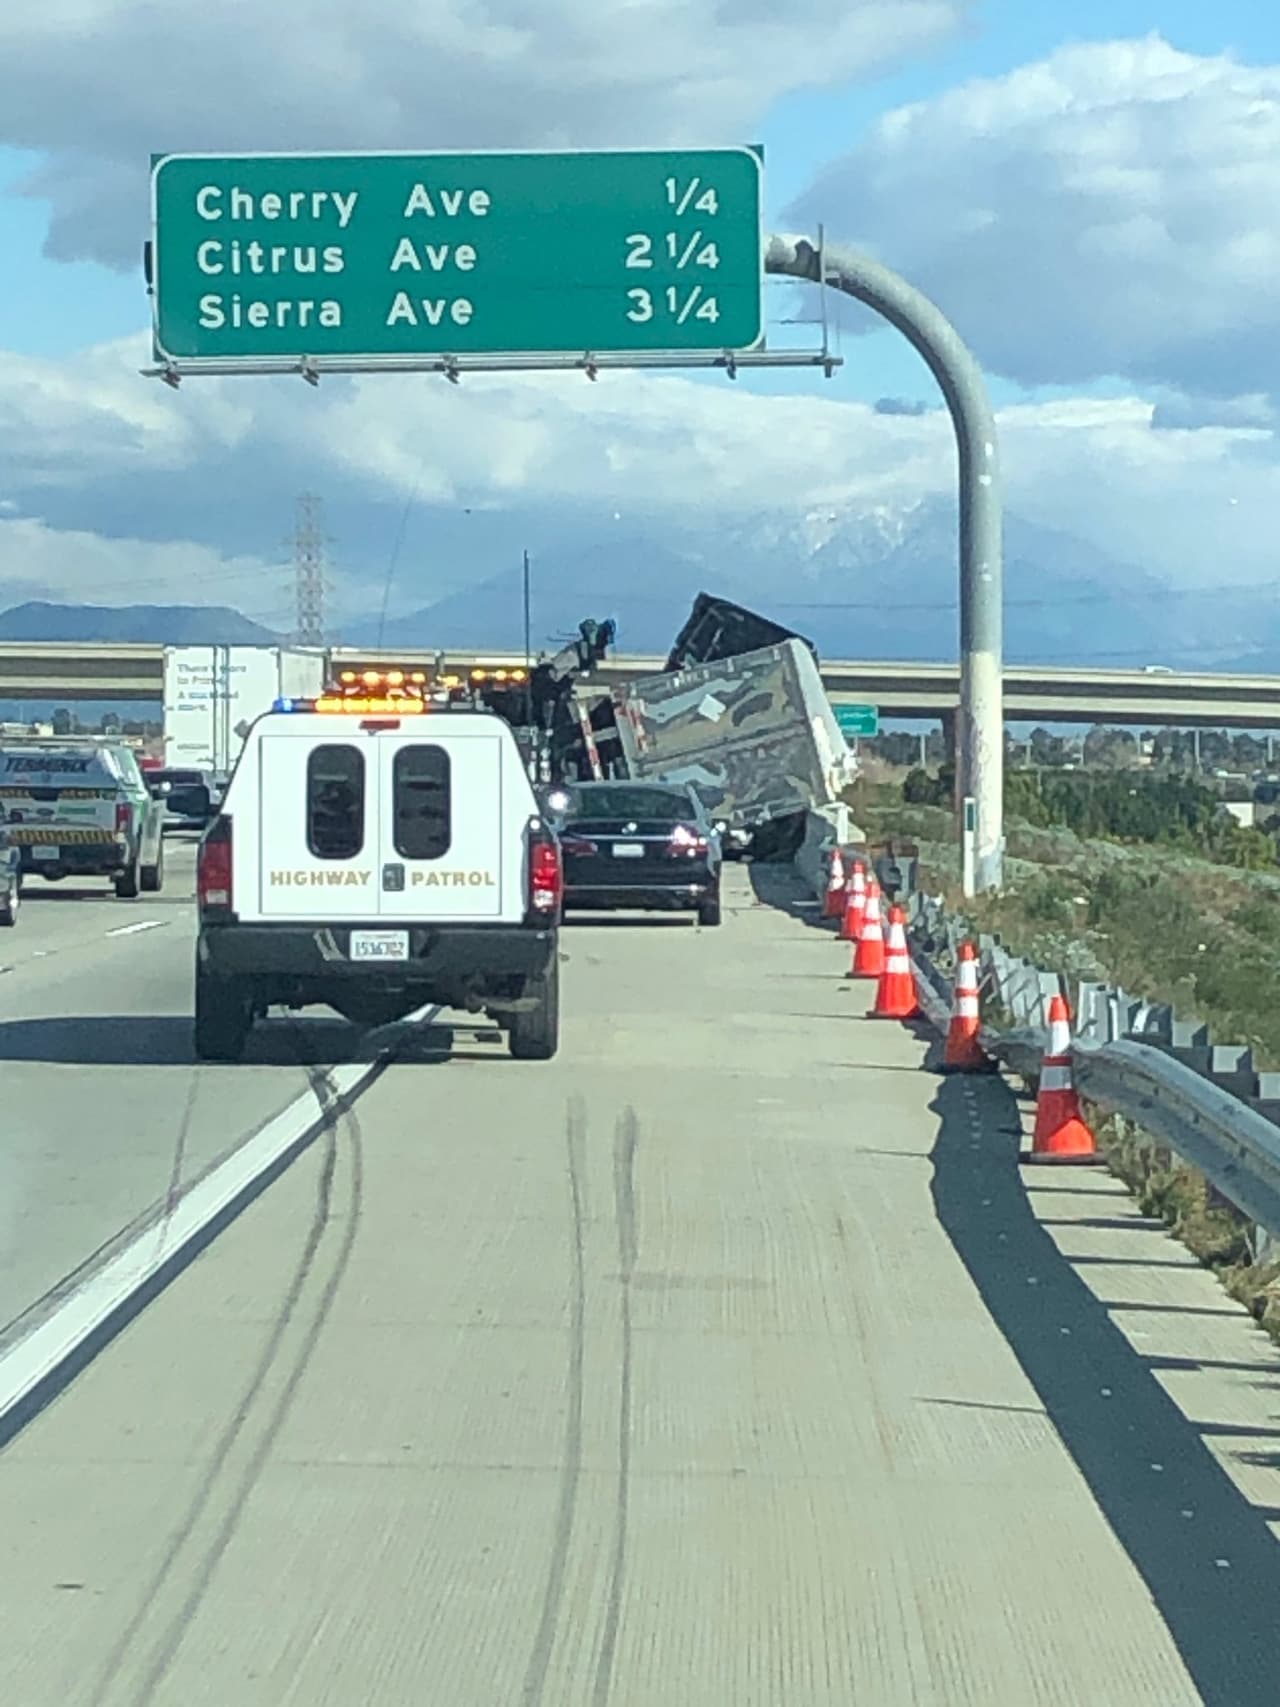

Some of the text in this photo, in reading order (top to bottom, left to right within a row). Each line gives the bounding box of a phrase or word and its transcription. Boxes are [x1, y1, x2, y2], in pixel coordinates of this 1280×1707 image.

[196, 186, 358, 228] Cherry
[404, 183, 491, 217] Ave
[197, 240, 345, 275] Citrus
[390, 238, 477, 272] Ave
[199, 294, 341, 329] Sierra
[386, 292, 473, 326] Ave
[270, 870, 495, 886] HIGHWAY PATROL
